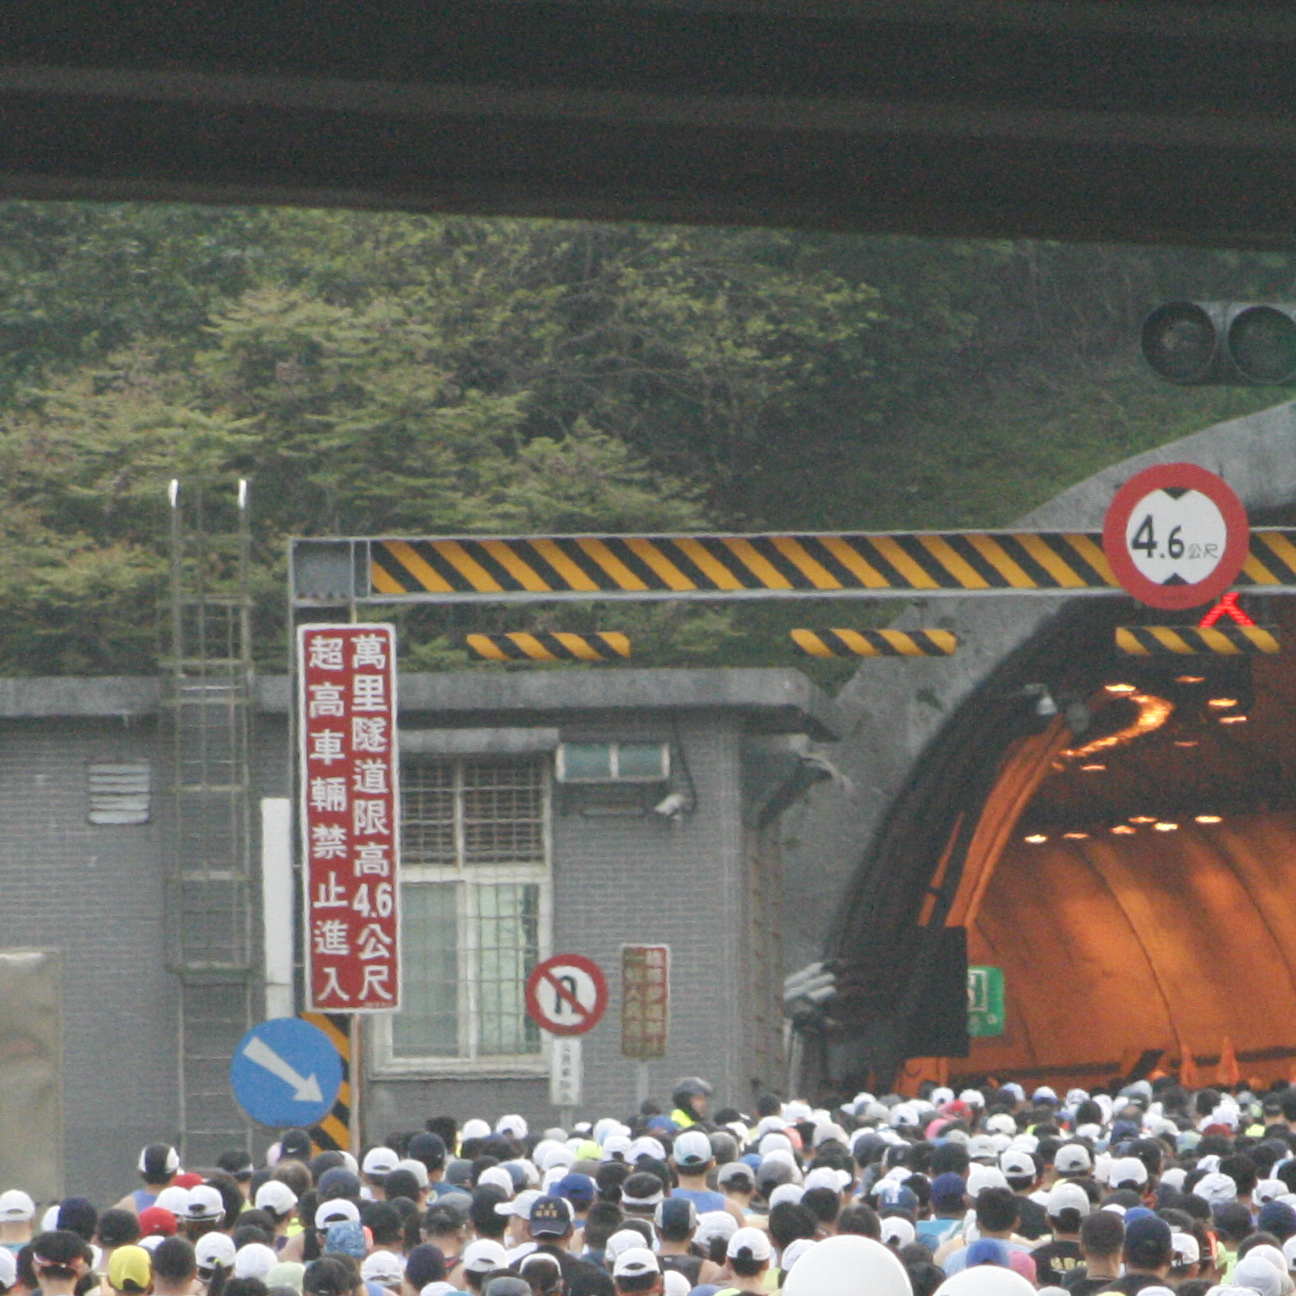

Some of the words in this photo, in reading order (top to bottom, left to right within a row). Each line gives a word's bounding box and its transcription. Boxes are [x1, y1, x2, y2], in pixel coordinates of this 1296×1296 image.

[308, 634, 351, 1002] 超高車輛禁止進入
